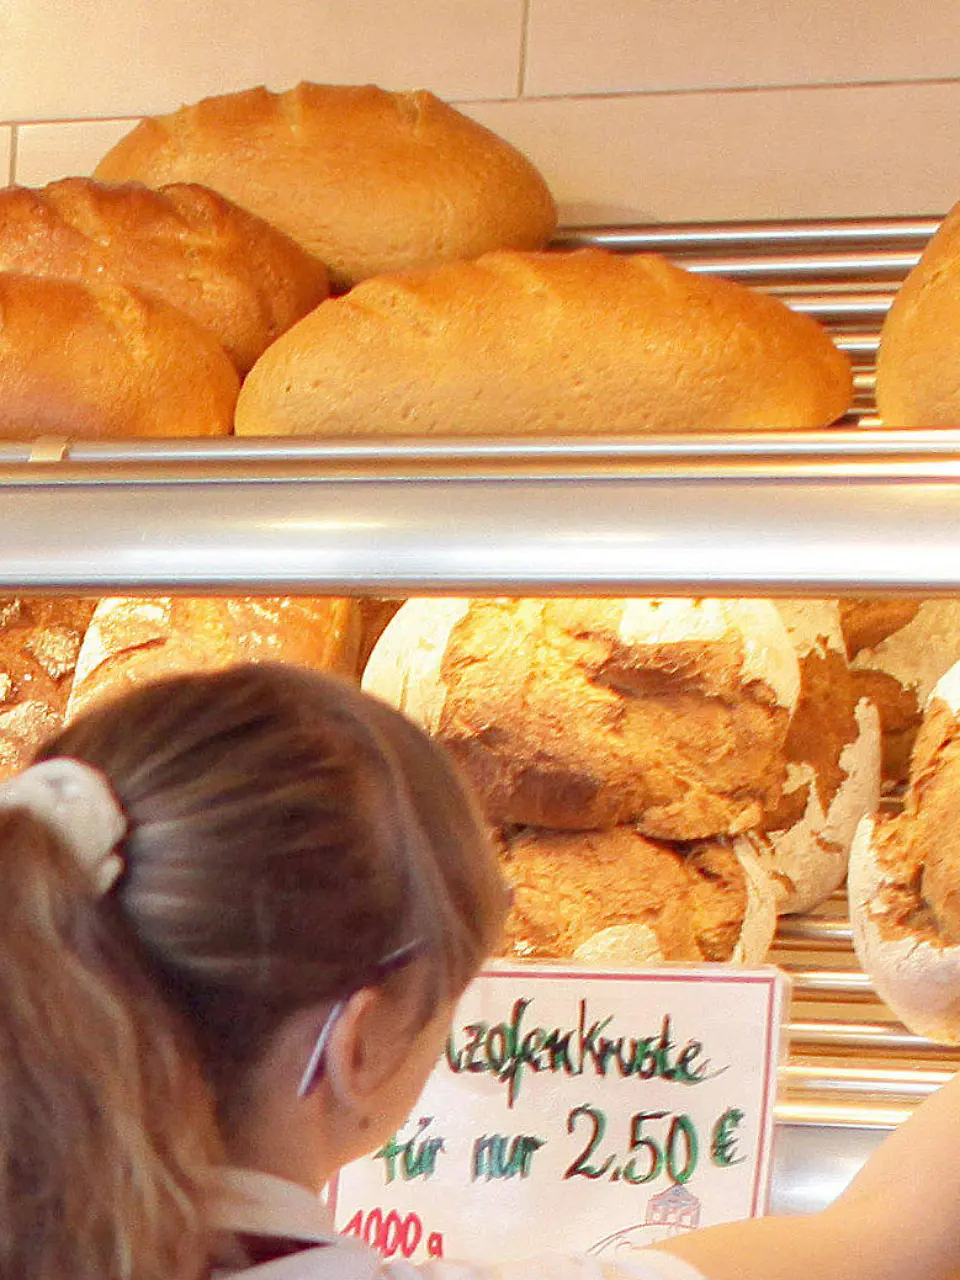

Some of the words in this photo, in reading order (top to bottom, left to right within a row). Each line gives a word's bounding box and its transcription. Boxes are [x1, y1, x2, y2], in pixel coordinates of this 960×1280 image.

[470, 1133, 547, 1184] nur
[562, 1102, 700, 1186] 2.50
[709, 1105, 748, 1169] €
[340, 1207, 423, 1259] 1000
